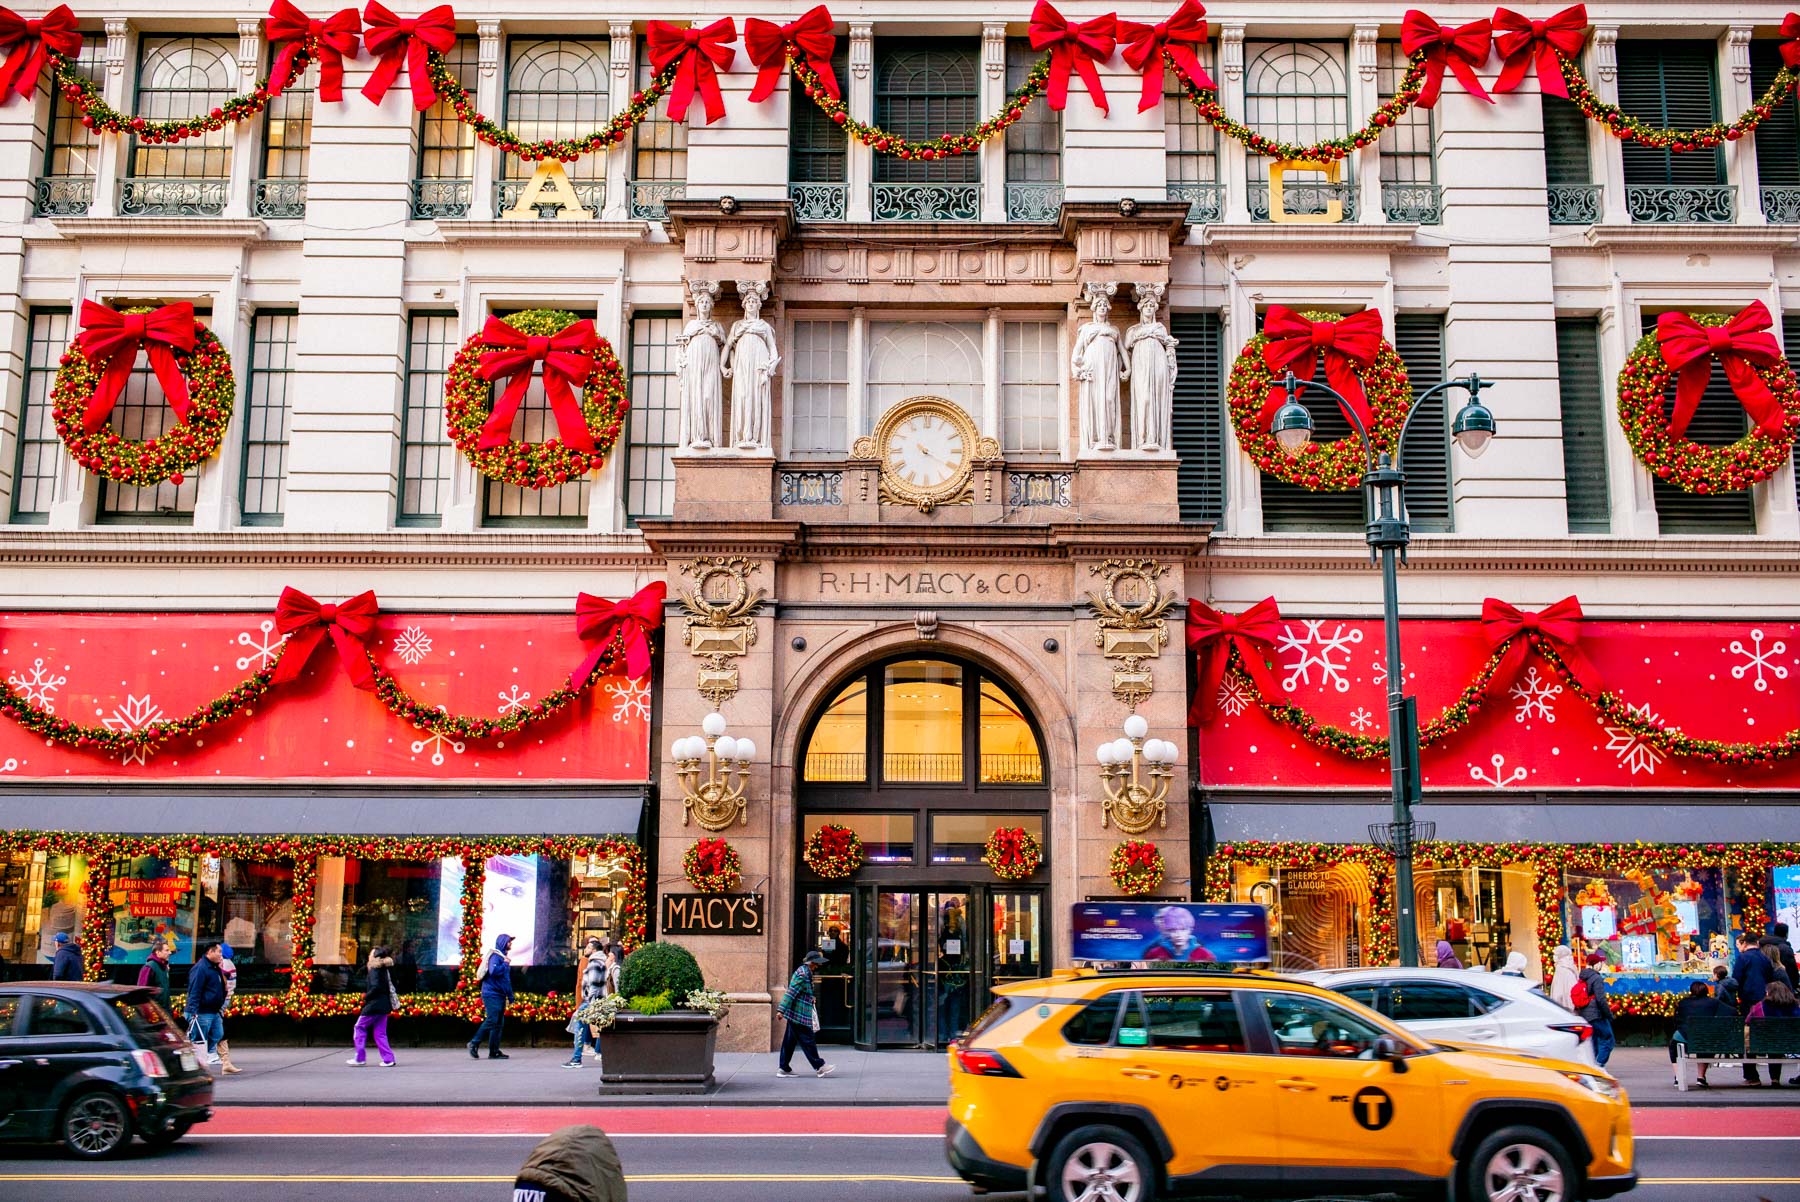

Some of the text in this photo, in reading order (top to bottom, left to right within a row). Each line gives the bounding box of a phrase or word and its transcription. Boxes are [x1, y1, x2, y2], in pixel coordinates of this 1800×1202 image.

[502, 156, 593, 219] A
[1288, 872, 1330, 880] CHEERS TO
[124, 880, 187, 889] BRING HOME
[1288, 881, 1326, 889] GLAMOUR
[131, 891, 181, 904] THE WONDER OF
[134, 906, 174, 915] KIEHL'S
[667, 897, 759, 929] MACY'S
[1359, 1095, 1386, 1125] T
